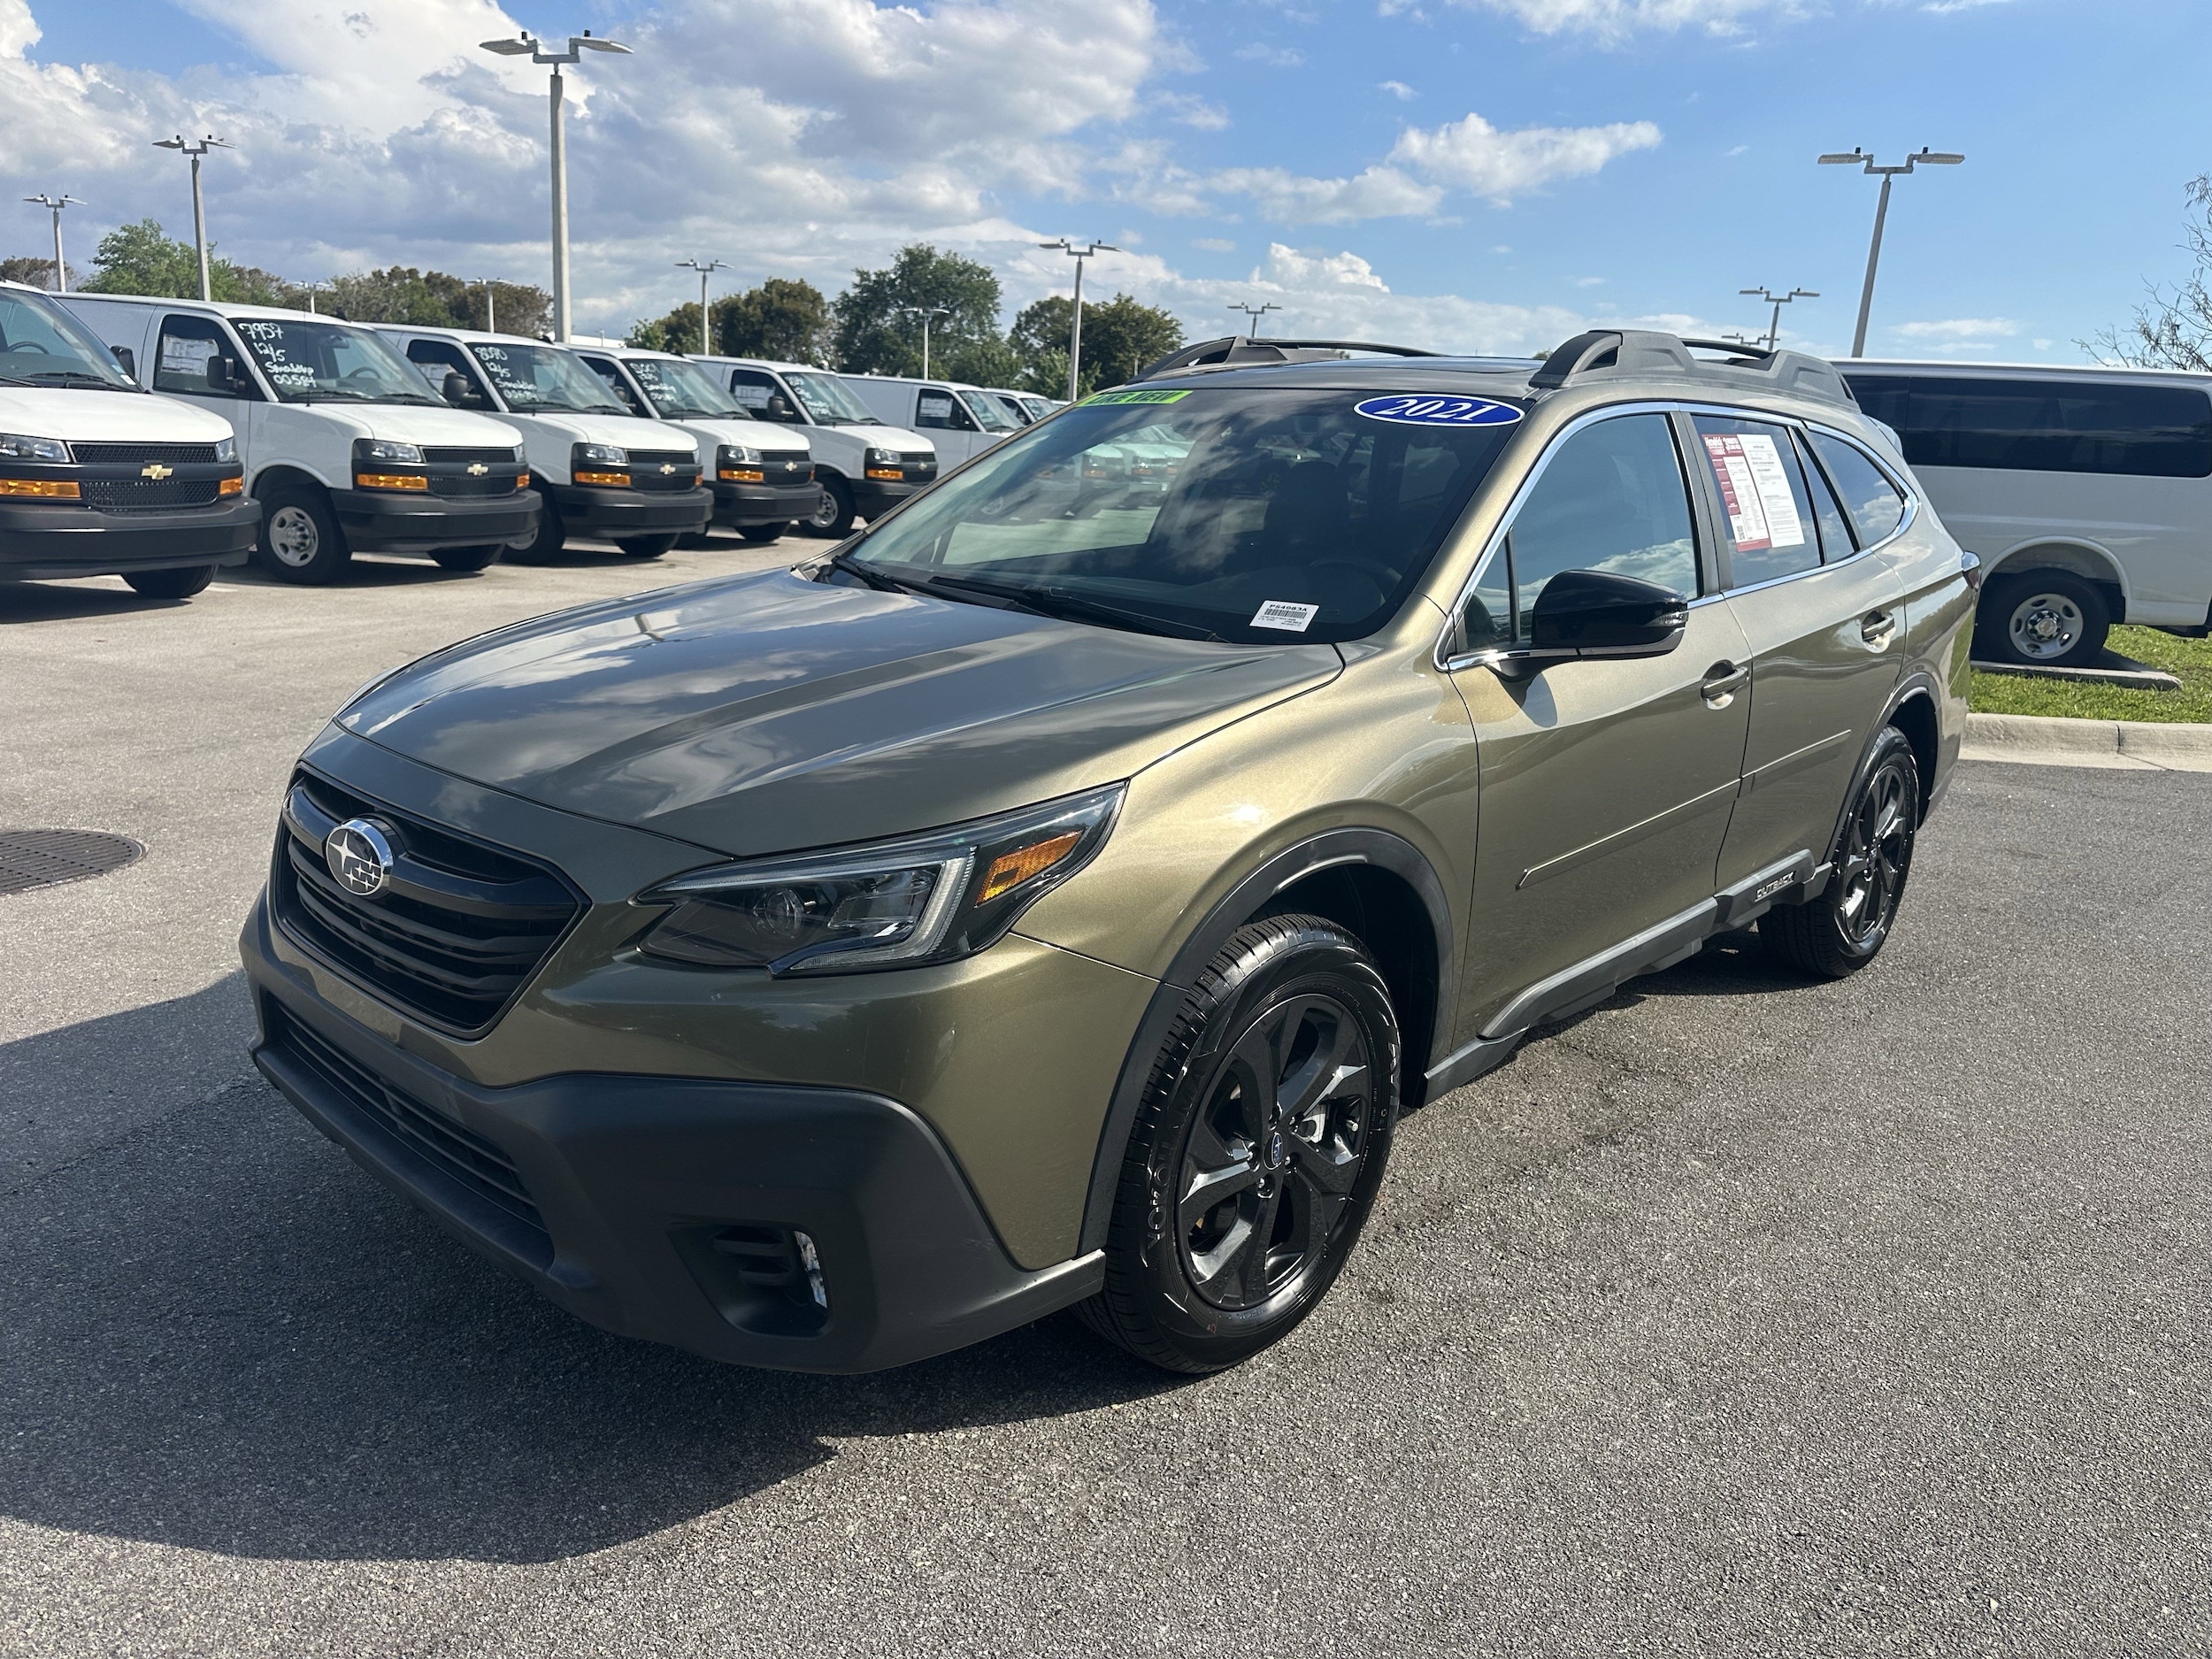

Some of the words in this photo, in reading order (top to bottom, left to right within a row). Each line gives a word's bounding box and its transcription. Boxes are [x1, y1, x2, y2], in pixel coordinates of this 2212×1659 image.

[238, 322, 284, 341] 7957
[253, 342, 286, 363] 12/5
[1125, 391, 1185, 403] NEW
[1373, 398, 1500, 421] 2021
[1756, 872, 1794, 898] OUTBACK
